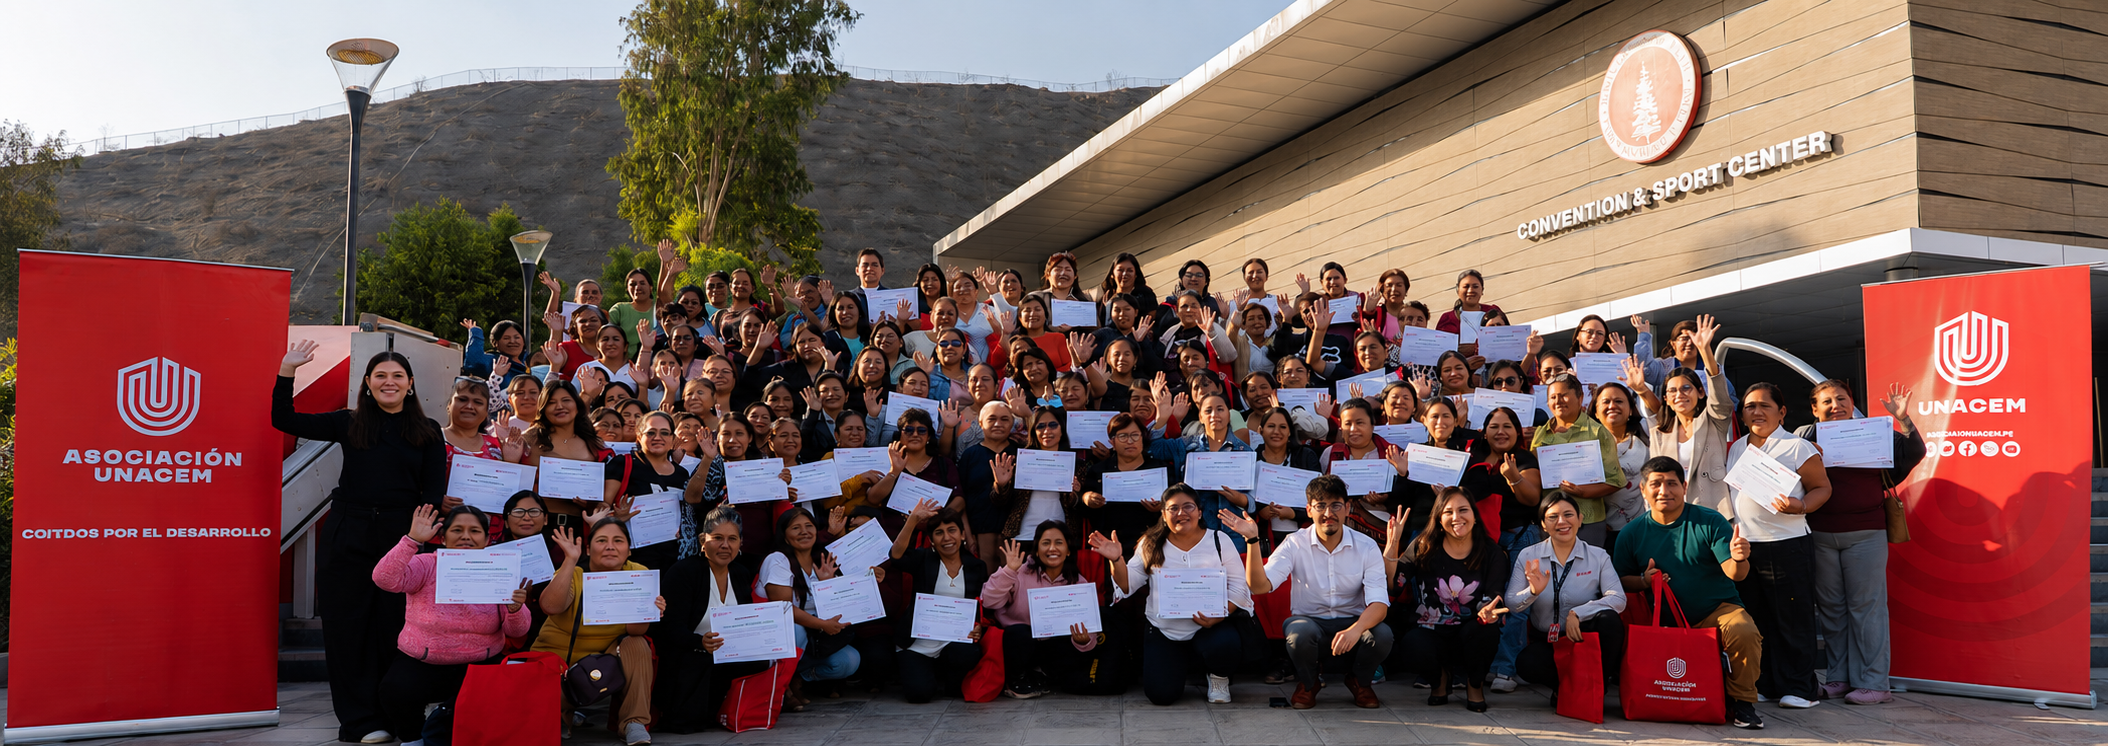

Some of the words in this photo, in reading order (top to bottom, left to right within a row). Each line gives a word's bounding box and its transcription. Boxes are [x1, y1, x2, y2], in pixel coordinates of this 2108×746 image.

[1517, 191, 1632, 240] CONVENTION
[1632, 187, 1648, 207] &
[1652, 162, 1724, 201] SPORT
[1727, 130, 1831, 178] CENTER
[1918, 398, 2026, 415] UNACEM
[62, 448, 242, 466] ASOCIACIÓN
[94, 467, 212, 483] UNACEM
[103, 528, 138, 538] POR
[142, 528, 162, 538] EL
[166, 527, 271, 538] DESARROLLO
